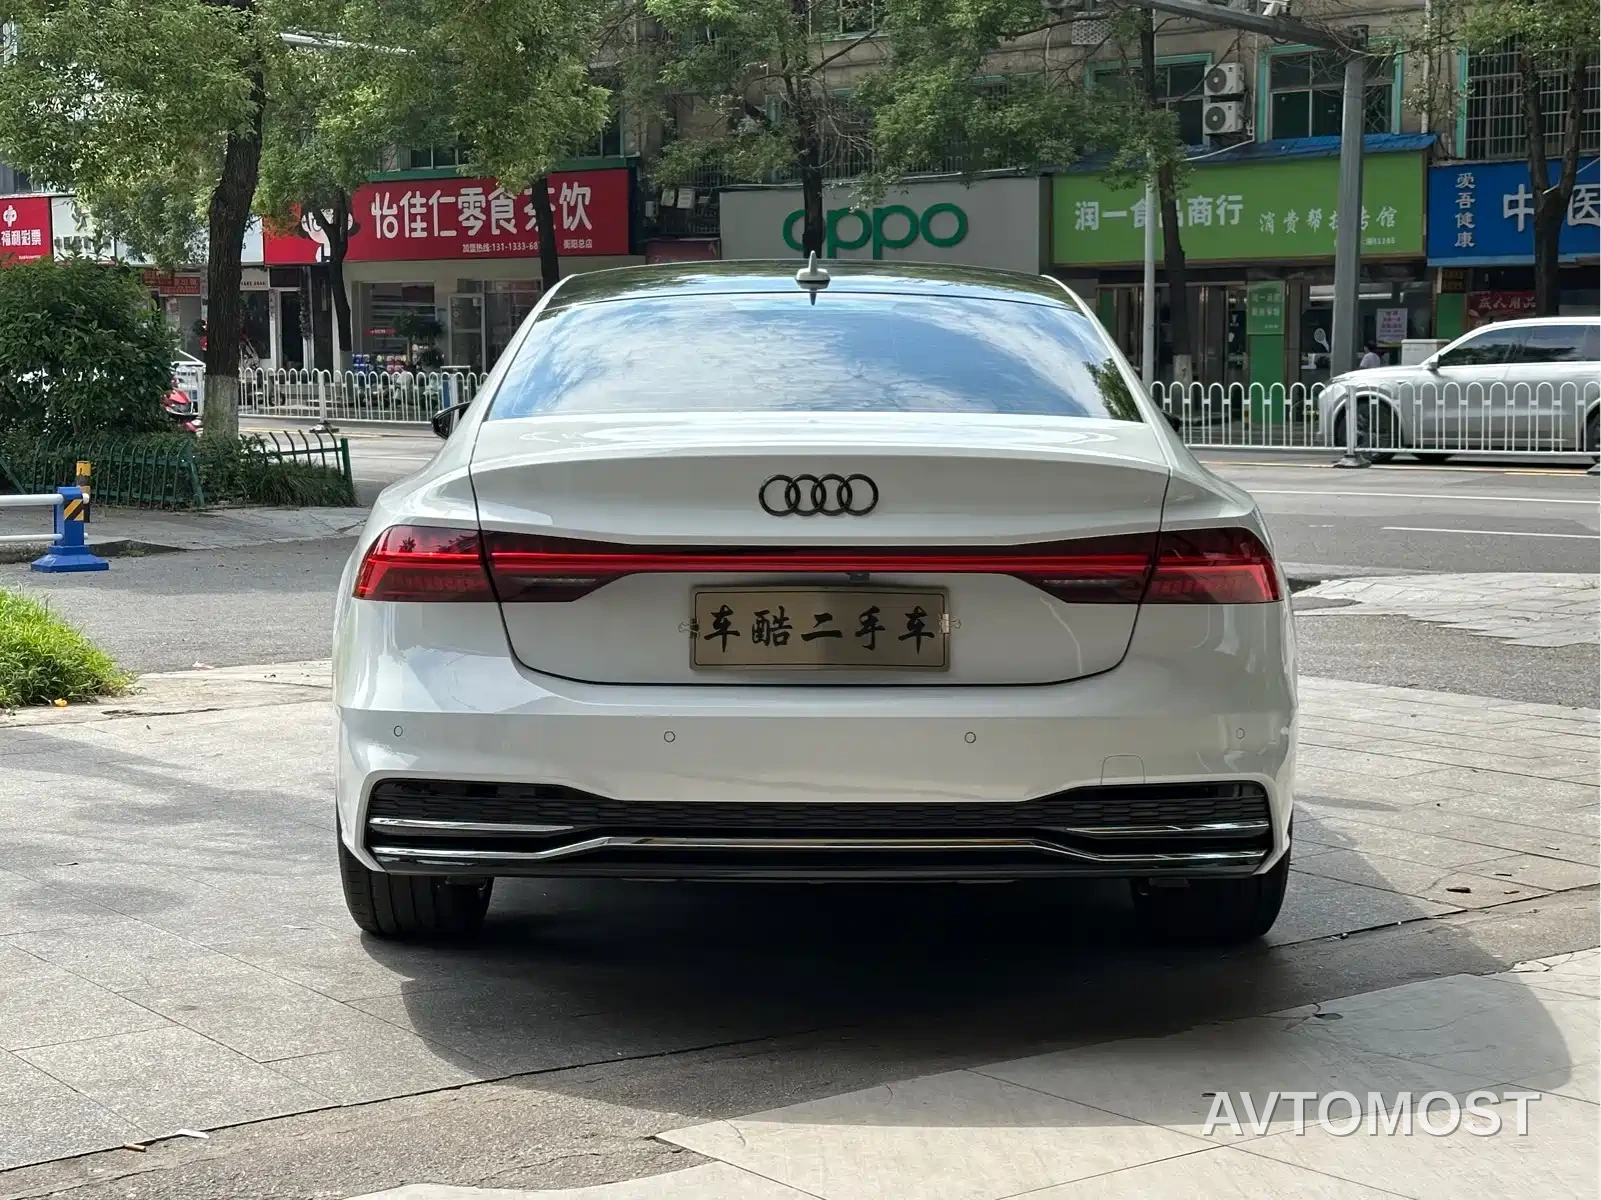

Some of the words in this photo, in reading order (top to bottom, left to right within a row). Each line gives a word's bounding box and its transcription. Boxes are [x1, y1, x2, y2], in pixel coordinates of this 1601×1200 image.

[783, 203, 968, 259] oppo
[1455, 172, 1476, 248] 爱吾健康
[1503, 183, 1600, 232] 中医
[1, 229, 42, 247] 福利彩票
[462, 241, 541, 253] 加盟热线:131-1333-68
[704, 604, 935, 654] 车酷二手车
